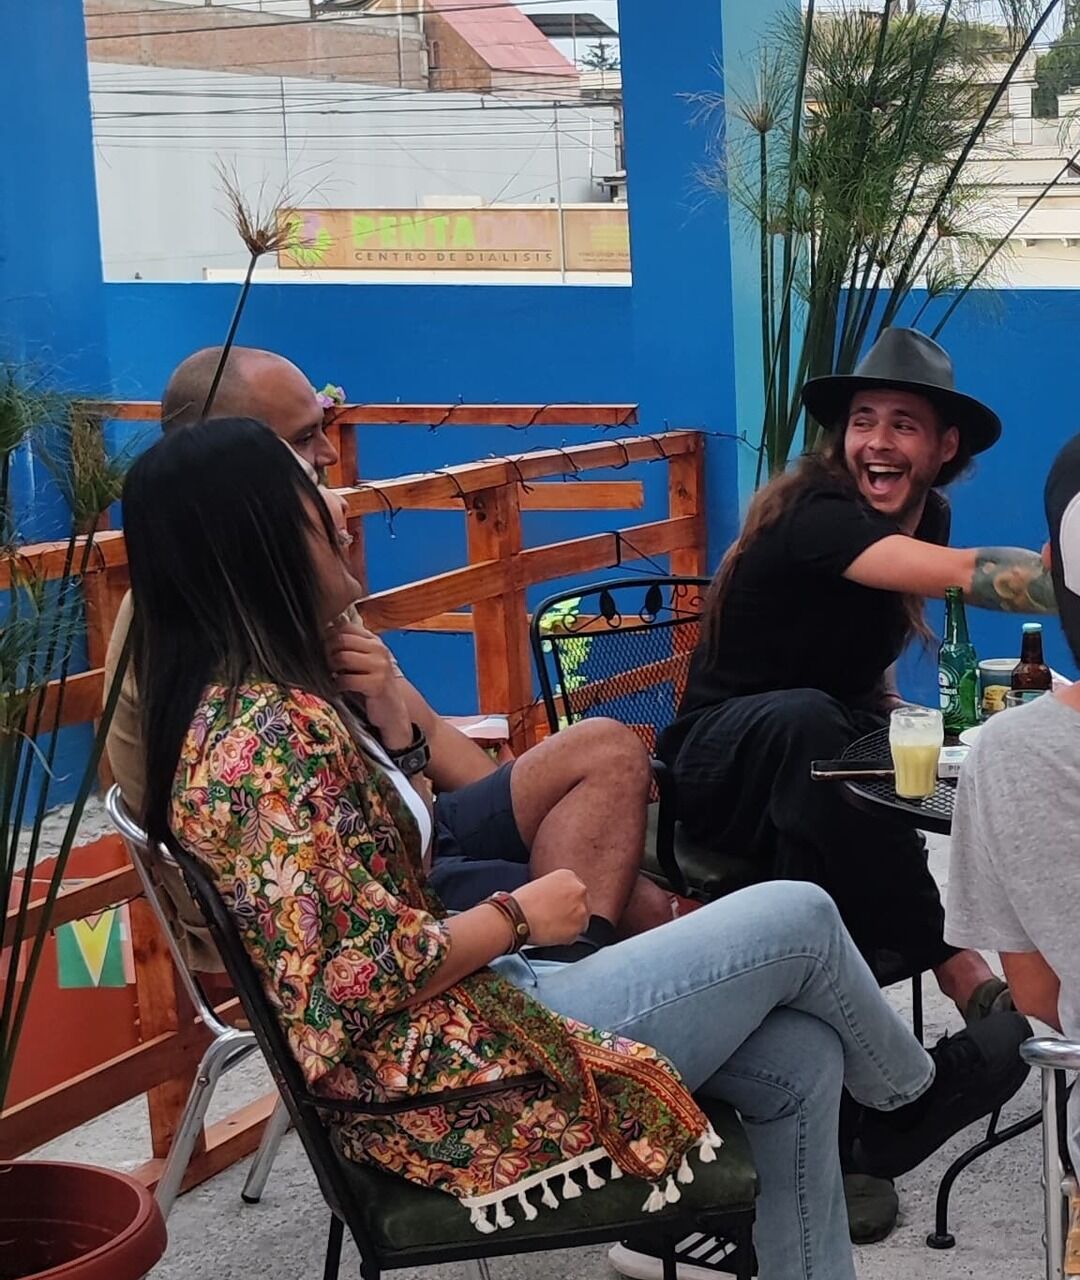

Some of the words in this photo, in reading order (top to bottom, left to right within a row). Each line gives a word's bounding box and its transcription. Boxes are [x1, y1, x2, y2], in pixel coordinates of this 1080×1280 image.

[355, 252, 427, 262] CENTRO
[436, 252, 457, 262] DE
[465, 252, 553, 262] DIALISIS
